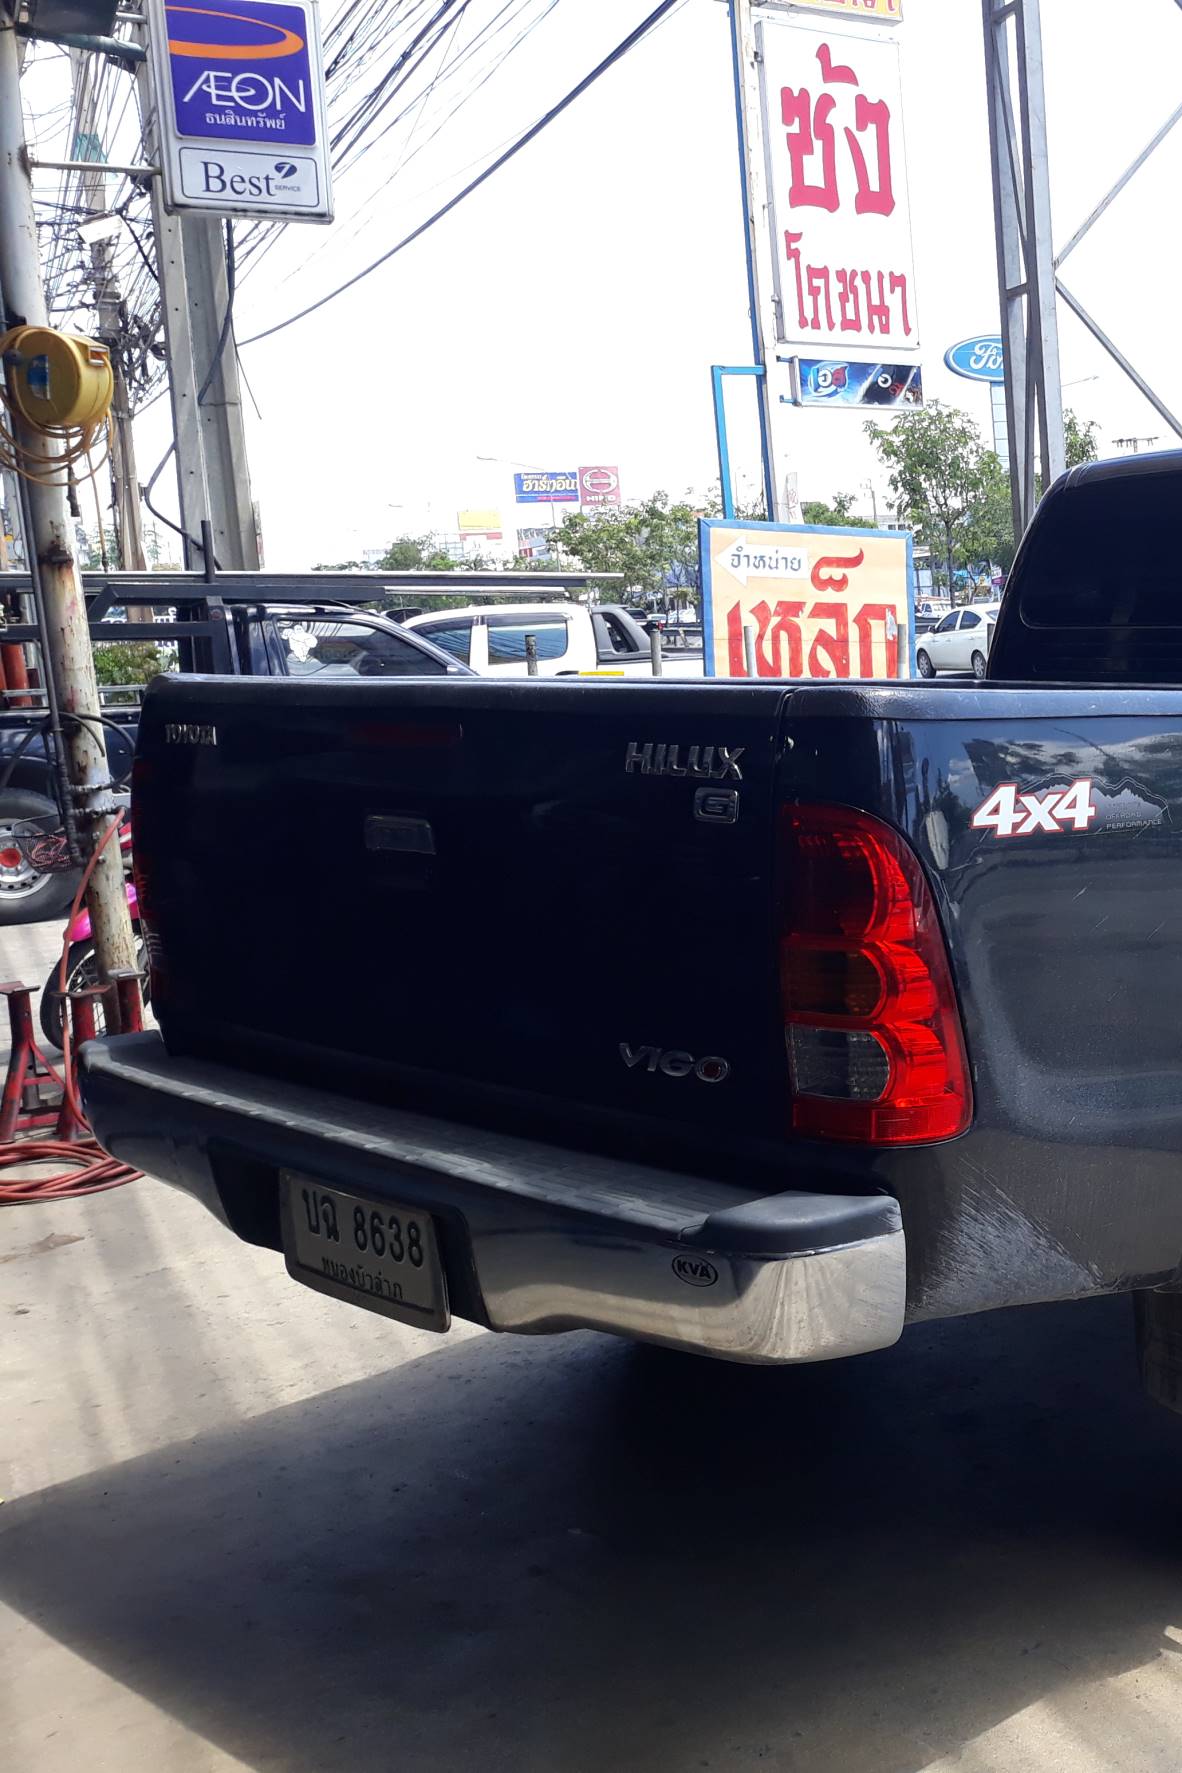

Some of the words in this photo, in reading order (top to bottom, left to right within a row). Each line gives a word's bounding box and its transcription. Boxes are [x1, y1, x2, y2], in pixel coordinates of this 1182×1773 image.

[205, 110, 286, 130] ธนสินทรัพย์
[201, 161, 276, 197] Best
[784, 229, 912, 336] โภชนา
[969, 342, 1003, 369] Fo
[625, 742, 745, 780] HILUX
[1106, 818, 1162, 830] PERFORMANCE
[619, 1042, 730, 1082] VIGO
[353, 1205, 424, 1268] 8638
[677, 1259, 711, 1279] KVA
